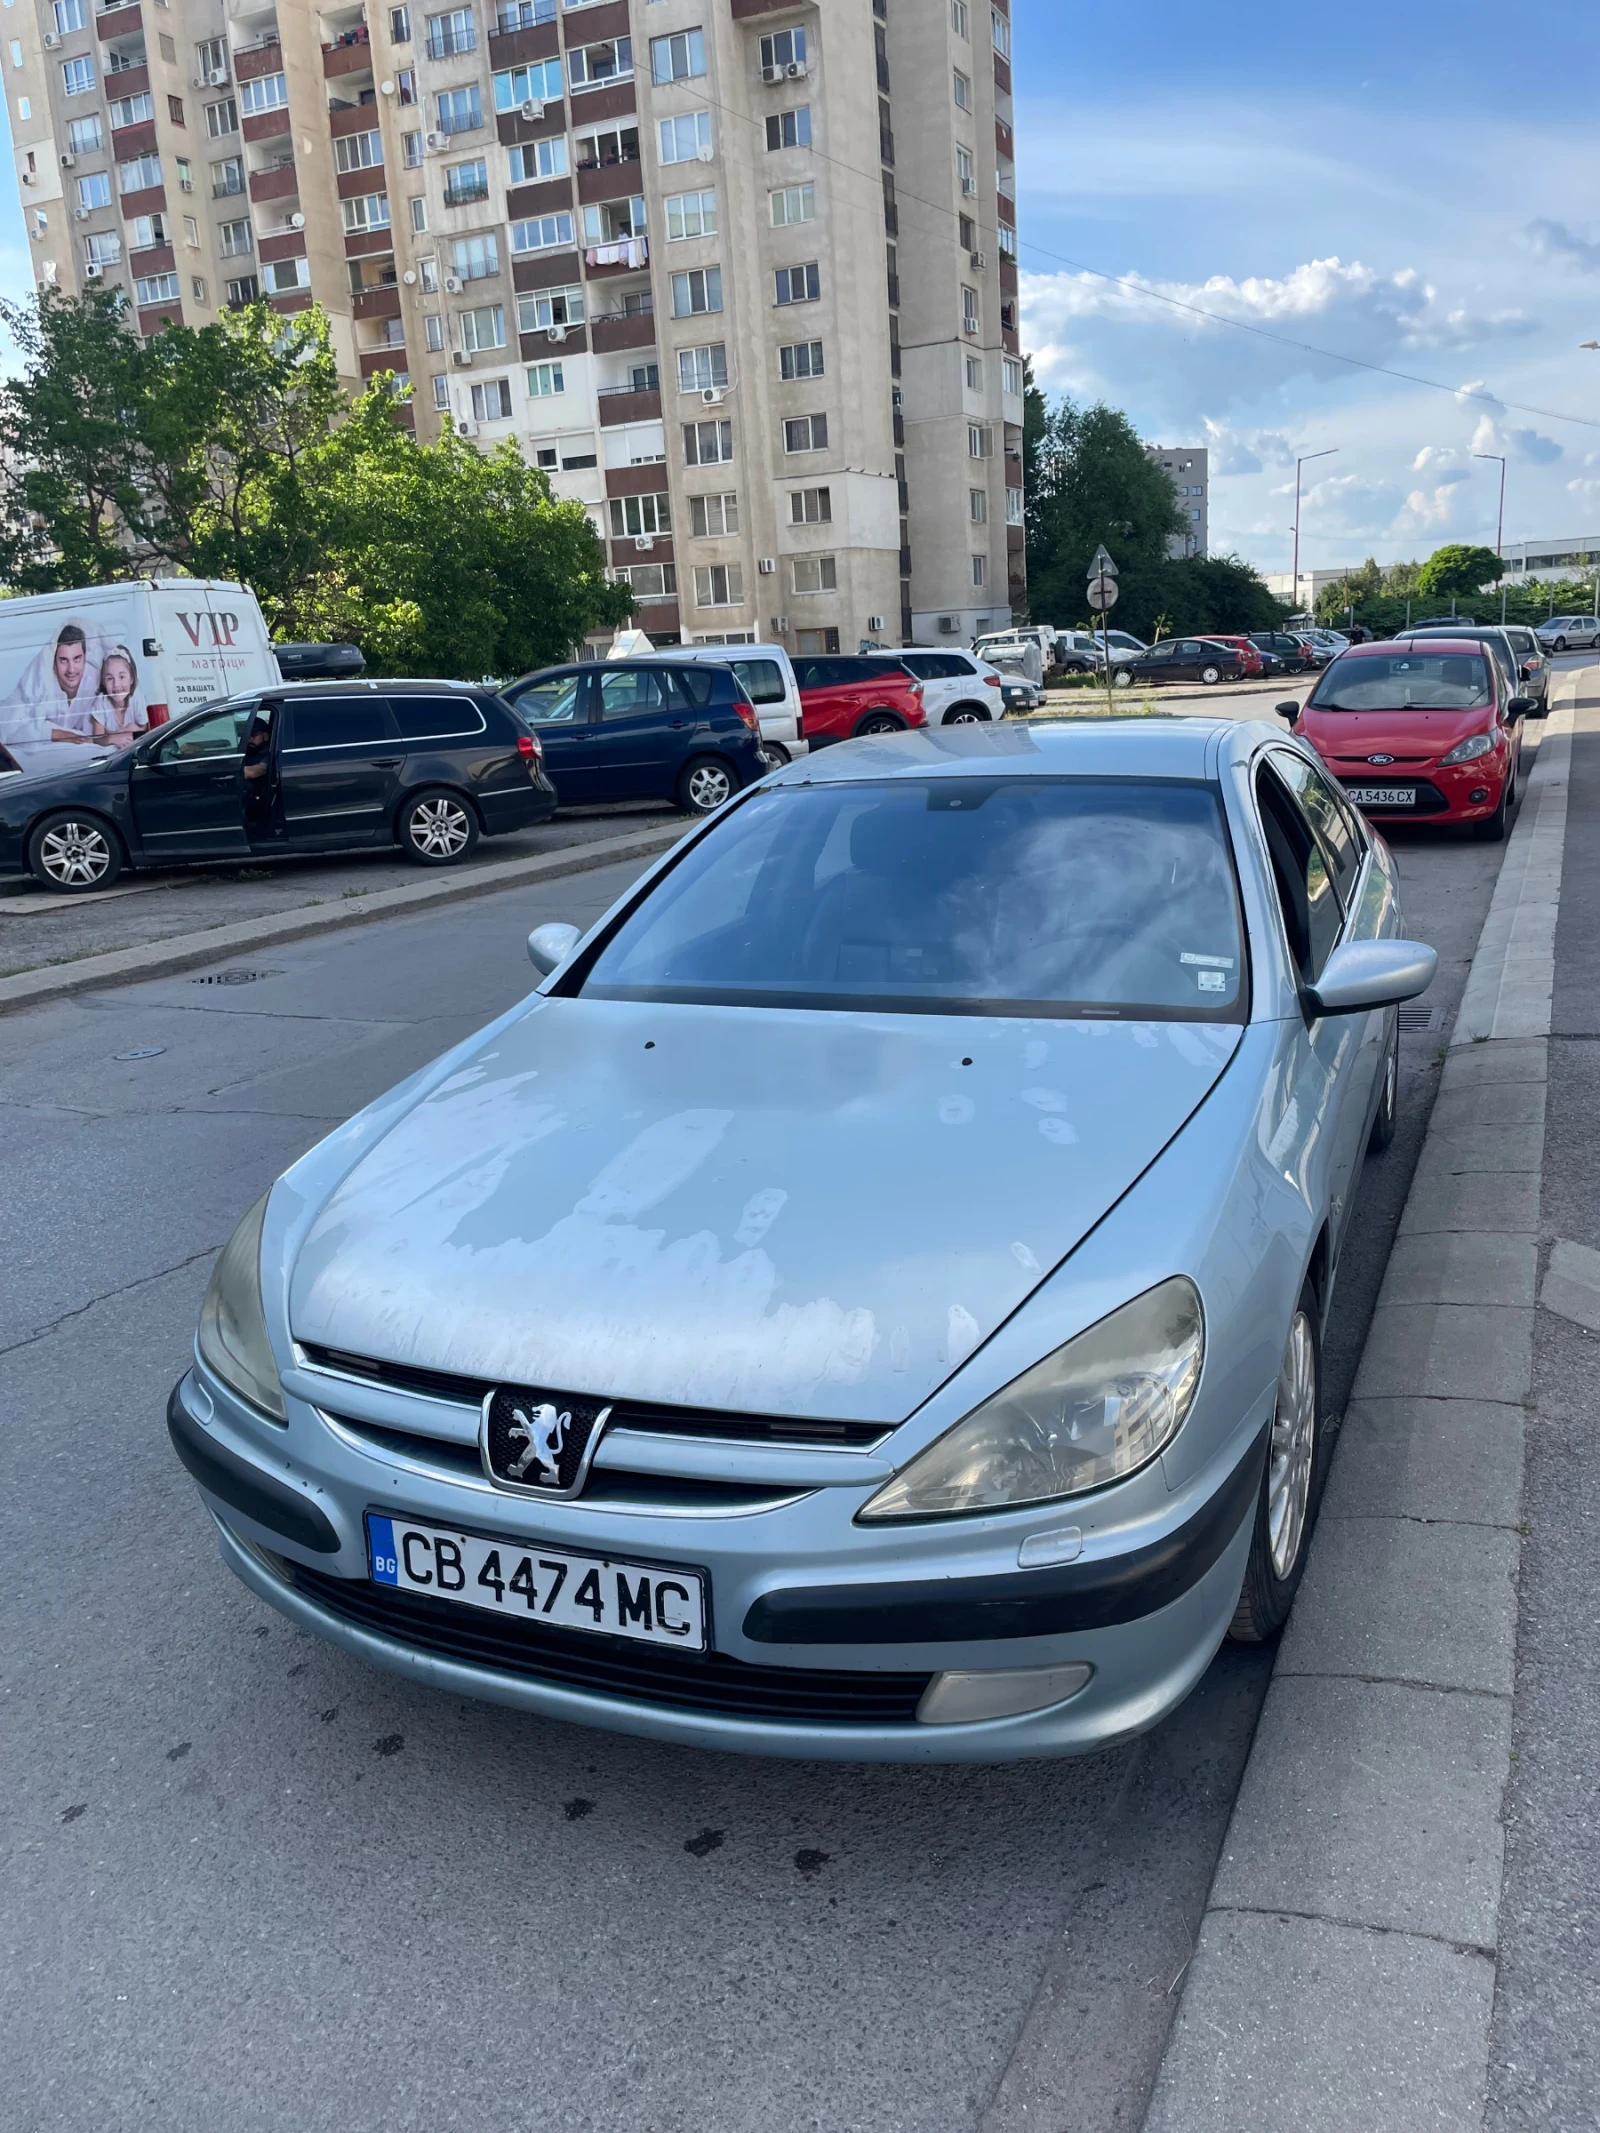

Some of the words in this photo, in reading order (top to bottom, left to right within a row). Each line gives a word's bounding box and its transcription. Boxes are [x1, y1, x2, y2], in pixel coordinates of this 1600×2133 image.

[175, 612, 239, 647] VIP
[176, 685, 186, 693] ЗА
[187, 684, 216, 692] ВАШАТА
[178, 696, 208, 704] СПАЛНЯ
[375, 1555, 397, 1574] BG
